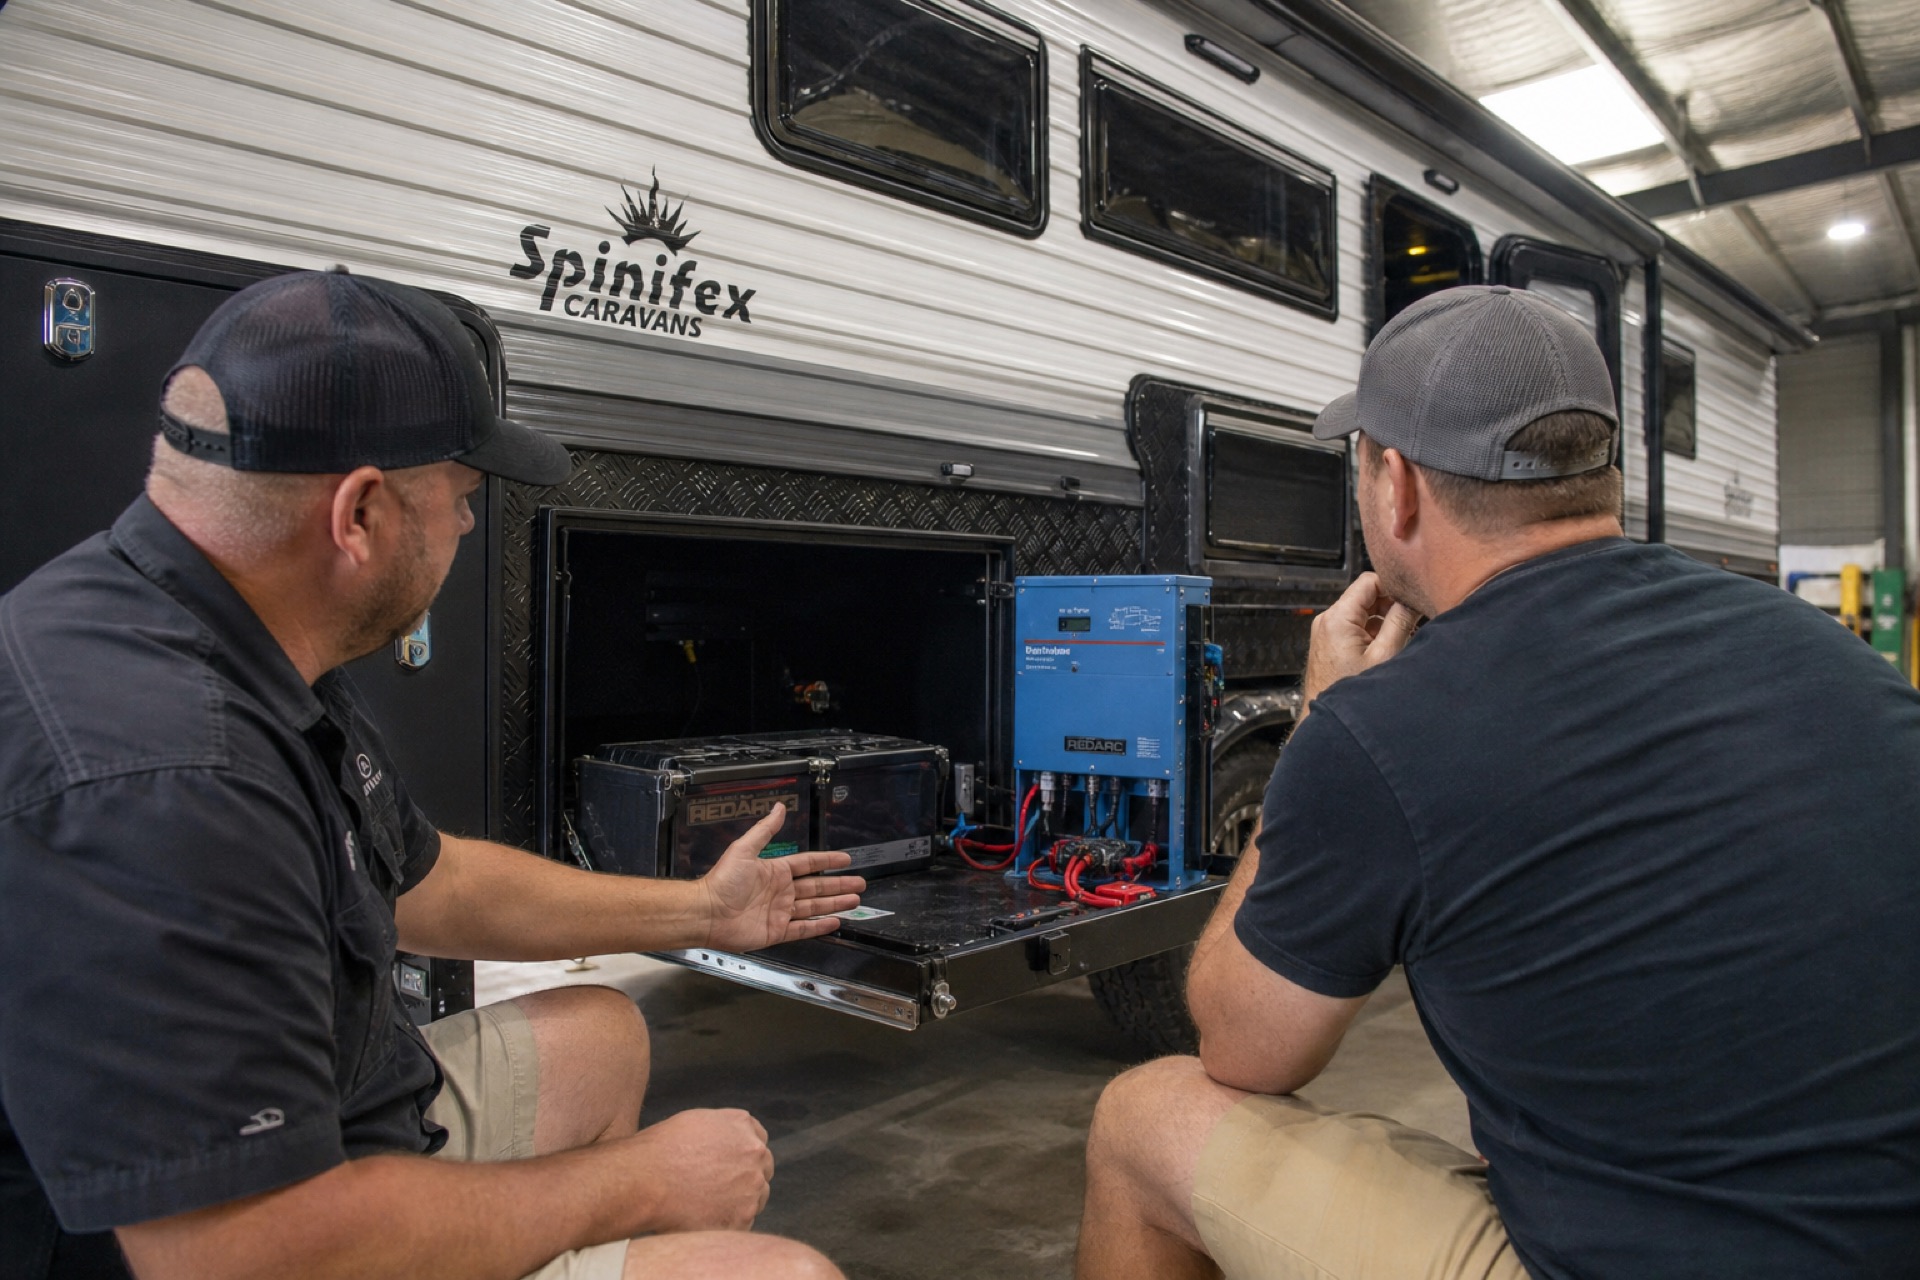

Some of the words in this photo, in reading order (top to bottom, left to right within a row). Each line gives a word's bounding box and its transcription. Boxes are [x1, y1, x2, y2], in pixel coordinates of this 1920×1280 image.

[510, 224, 756, 324] Spinifex
[564, 294, 703, 338] CARAVANS
[1067, 740, 1124, 752] REDARC
